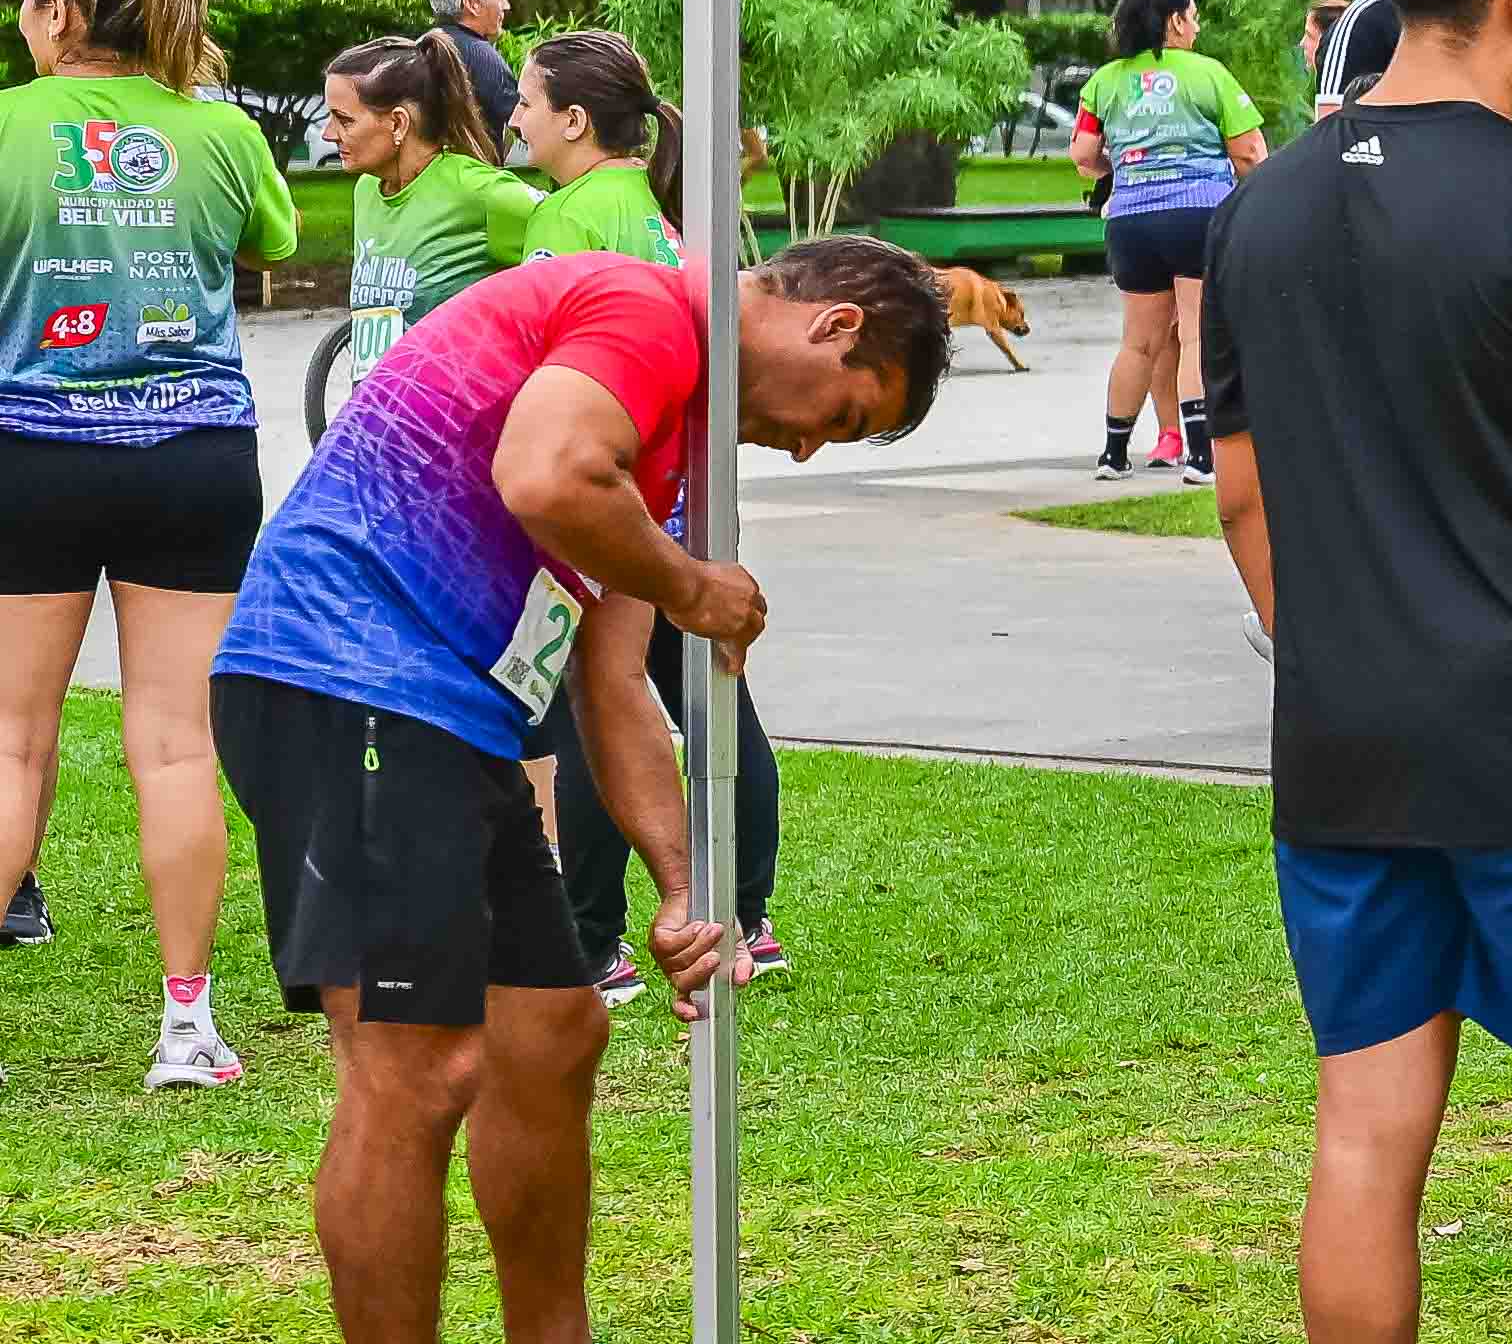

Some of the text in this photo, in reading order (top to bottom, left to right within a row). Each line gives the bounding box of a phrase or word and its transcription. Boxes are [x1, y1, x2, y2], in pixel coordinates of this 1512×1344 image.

[58, 197, 176, 209] MUNICIPALIDAD DE
[58, 209, 176, 226] BELL VILLE
[52, 310, 96, 339] 4:8
[68, 390, 124, 412] Bell
[129, 379, 201, 410] Ville!
